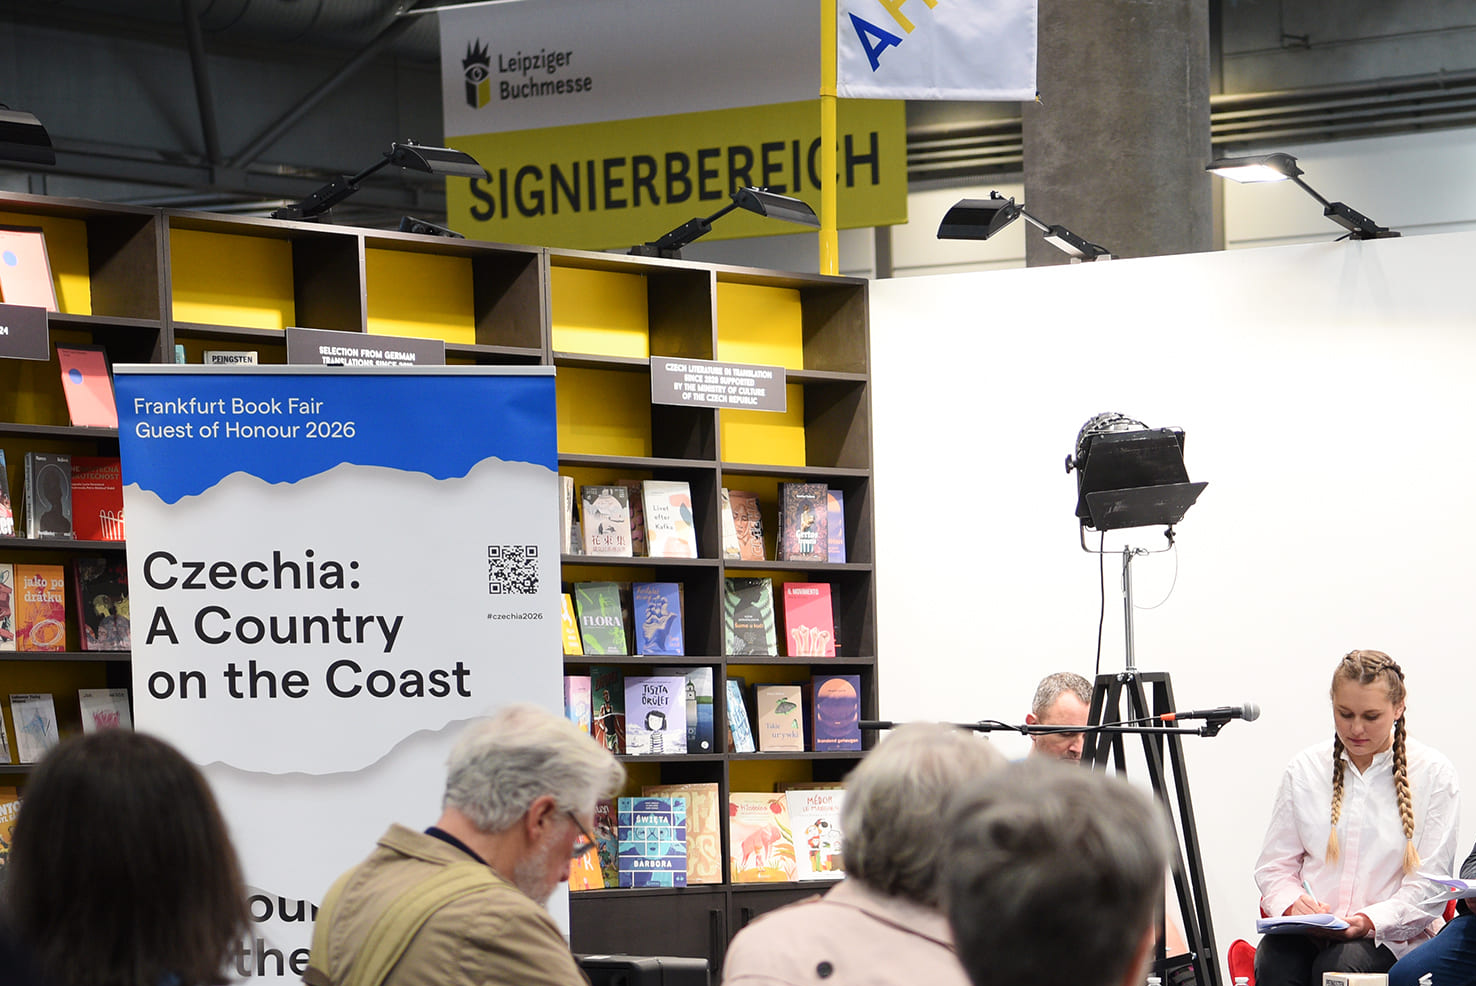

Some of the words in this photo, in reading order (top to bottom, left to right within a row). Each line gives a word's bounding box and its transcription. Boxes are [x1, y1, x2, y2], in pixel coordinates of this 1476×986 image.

[498, 49, 573, 77] Leipziger
[499, 76, 593, 101] Buchmesse
[468, 131, 882, 223] SIGNIERBEREICH
[319, 346, 359, 356] SELECTION
[361, 348, 383, 359] FROM
[384, 350, 416, 361] GERMAN
[665, 363, 687, 373] CZECH
[688, 364, 723, 376] LITERATURE
[733, 368, 773, 379] TRANSLATION
[684, 373, 704, 383] SINCE
[720, 376, 755, 387] SUPPORTED
[674, 382, 682, 391] BY
[684, 382, 697, 392] THE
[697, 383, 726, 394] MINISTRY
[728, 385, 737, 395] OF
[738, 387, 766, 397] CULTURE
[682, 391, 692, 400] OF
[693, 392, 705, 402] THE
[706, 393, 727, 403] CZECH
[729, 395, 758, 405] REPUBLIC
[134, 397, 226, 415] Frankfurt
[231, 397, 283, 415] Book
[288, 397, 324, 415] Fair
[135, 421, 194, 439] Guest
[200, 420, 221, 439] of
[225, 421, 301, 439] Honour
[305, 421, 356, 439] 2026
[143, 549, 361, 591] Czechia:
[24, 576, 47, 589] jako
[51, 579, 64, 590] po
[24, 591, 62, 602] drátku
[487, 612, 544, 621] #czechia2026
[583, 616, 621, 626] FLORA
[145, 606, 179, 645] A
[193, 604, 403, 653] Country
[147, 668, 207, 699] on
[223, 660, 309, 699] the
[325, 659, 472, 699] Coast
[642, 684, 668, 695] TISZTA
[636, 814, 669, 825] ŚWIĘTA
[634, 860, 672, 868] BARBORA
